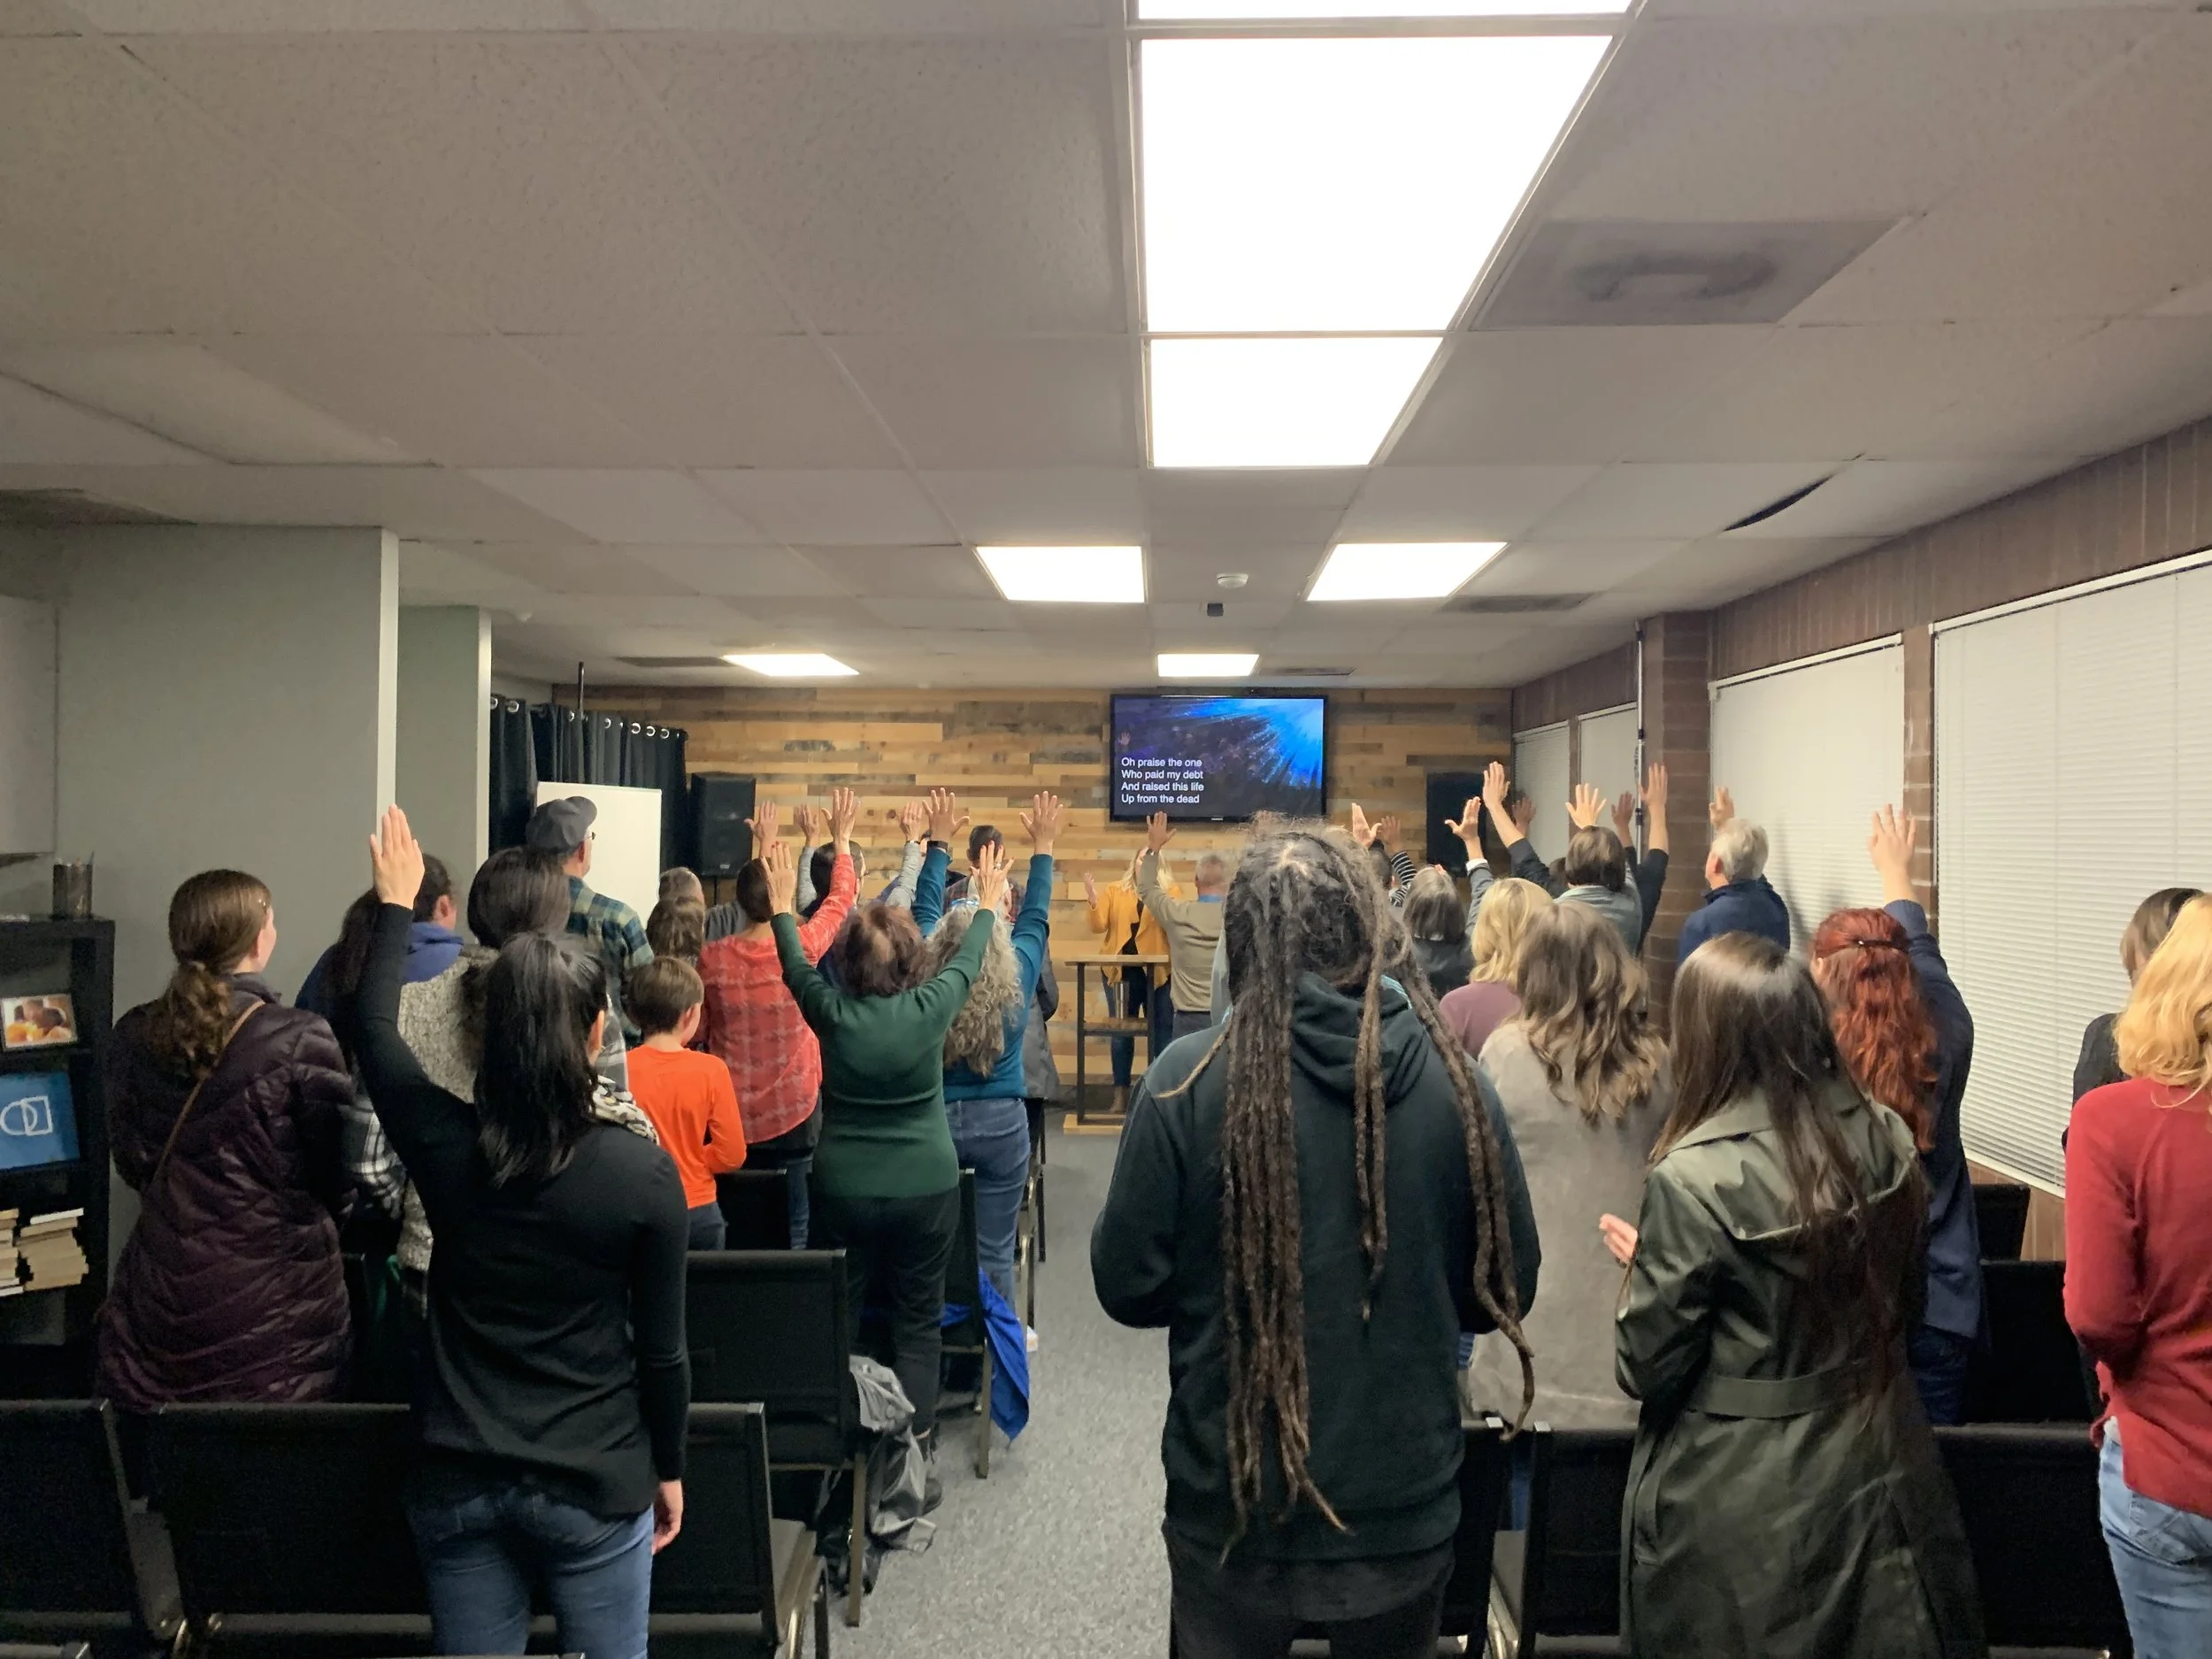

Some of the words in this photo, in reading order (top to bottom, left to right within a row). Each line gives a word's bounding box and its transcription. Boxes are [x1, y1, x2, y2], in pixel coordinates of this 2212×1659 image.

[1121, 757, 1135, 767] Oh
[1138, 757, 1166, 768] praise
[1167, 757, 1183, 767] the
[1121, 769, 1143, 779] Who
[1144, 769, 1165, 781] paid
[1166, 772, 1181, 781] my
[1182, 770, 1204, 779] debt
[1121, 781, 1141, 791] And
[1141, 781, 1171, 791] raised
[1171, 781, 1189, 791] this
[1190, 781, 1205, 791] life
[1121, 794, 1135, 804] Up
[1136, 794, 1158, 803] from
[1159, 794, 1175, 803] the
[1176, 794, 1201, 803] dead
